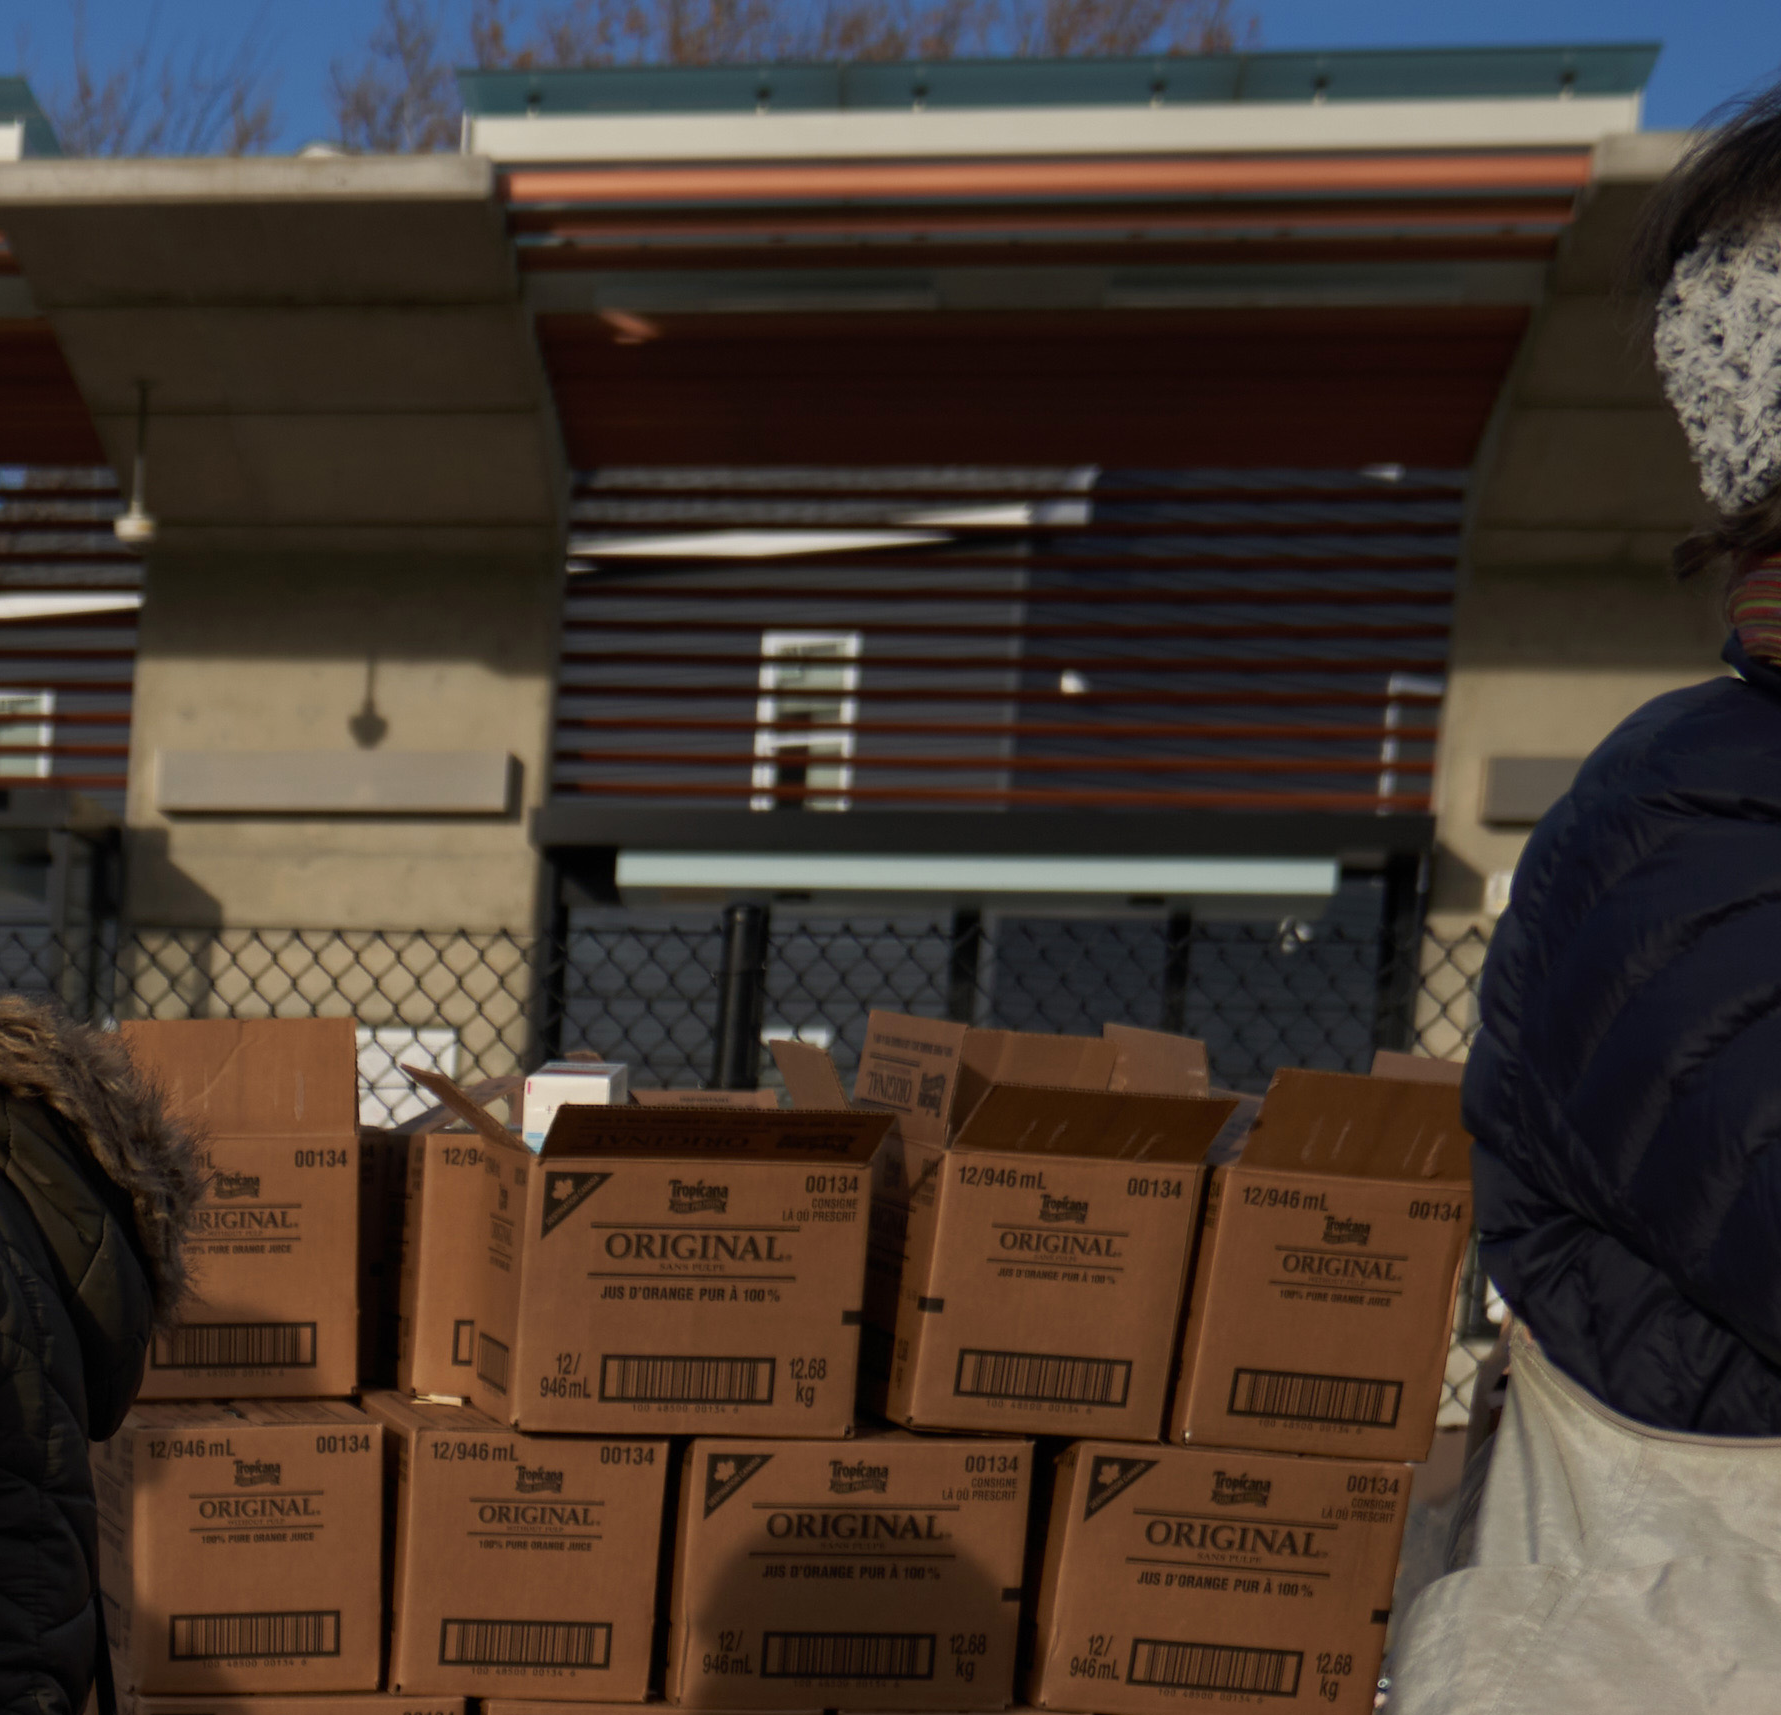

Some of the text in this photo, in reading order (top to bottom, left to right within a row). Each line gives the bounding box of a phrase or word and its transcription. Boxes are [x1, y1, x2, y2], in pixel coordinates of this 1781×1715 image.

[294, 1150, 347, 1167] 00134
[669, 1179, 728, 1201] Tropicana
[806, 1176, 858, 1194] 00134
[958, 1166, 1016, 1187] 12/946
[1127, 1178, 1182, 1199] 00134
[812, 1198, 858, 1210] CONSIGNE
[1040, 1194, 1088, 1212] Tropicana
[1409, 1201, 1461, 1222] 00134
[812, 1211, 856, 1222] PRESCRIT
[605, 1233, 784, 1262] ORIGINAL
[999, 1231, 1116, 1257] ORIGINAL
[1283, 1254, 1397, 1281] ORIGINAL
[601, 1286, 624, 1300] JUS
[630, 1286, 693, 1301] D'ORANGE
[699, 1287, 725, 1301] PUR
[556, 1353, 827, 1379] 12/ 12.68
[795, 1383, 815, 1407] kg
[148, 1440, 205, 1460] 12/946
[316, 1435, 370, 1454] 00134
[432, 1442, 489, 1461] 12/946
[600, 1446, 654, 1465] 00134
[233, 1459, 281, 1475] Tropicana
[516, 1465, 563, 1482] Tropicana
[829, 1460, 888, 1481] Tropicana
[965, 1455, 1018, 1473] 00134
[1213, 1471, 1271, 1495] Tropicana
[1346, 1475, 1399, 1494] 00134
[199, 1498, 316, 1518] ORIGINAL
[478, 1505, 596, 1526] ORIGINAL
[767, 1513, 944, 1540] ORIGINAL
[201, 1532, 315, 1544] 100% PURE ORANGE JUICE
[1145, 1520, 1321, 1558] ORIGINAL
[1137, 1571, 1160, 1585] JUS
[1165, 1574, 1228, 1591] D'ORANGE
[1234, 1579, 1259, 1593] PUR
[1088, 1635, 1352, 1676] 12/ 12.68
[1319, 1677, 1338, 1701] kg
